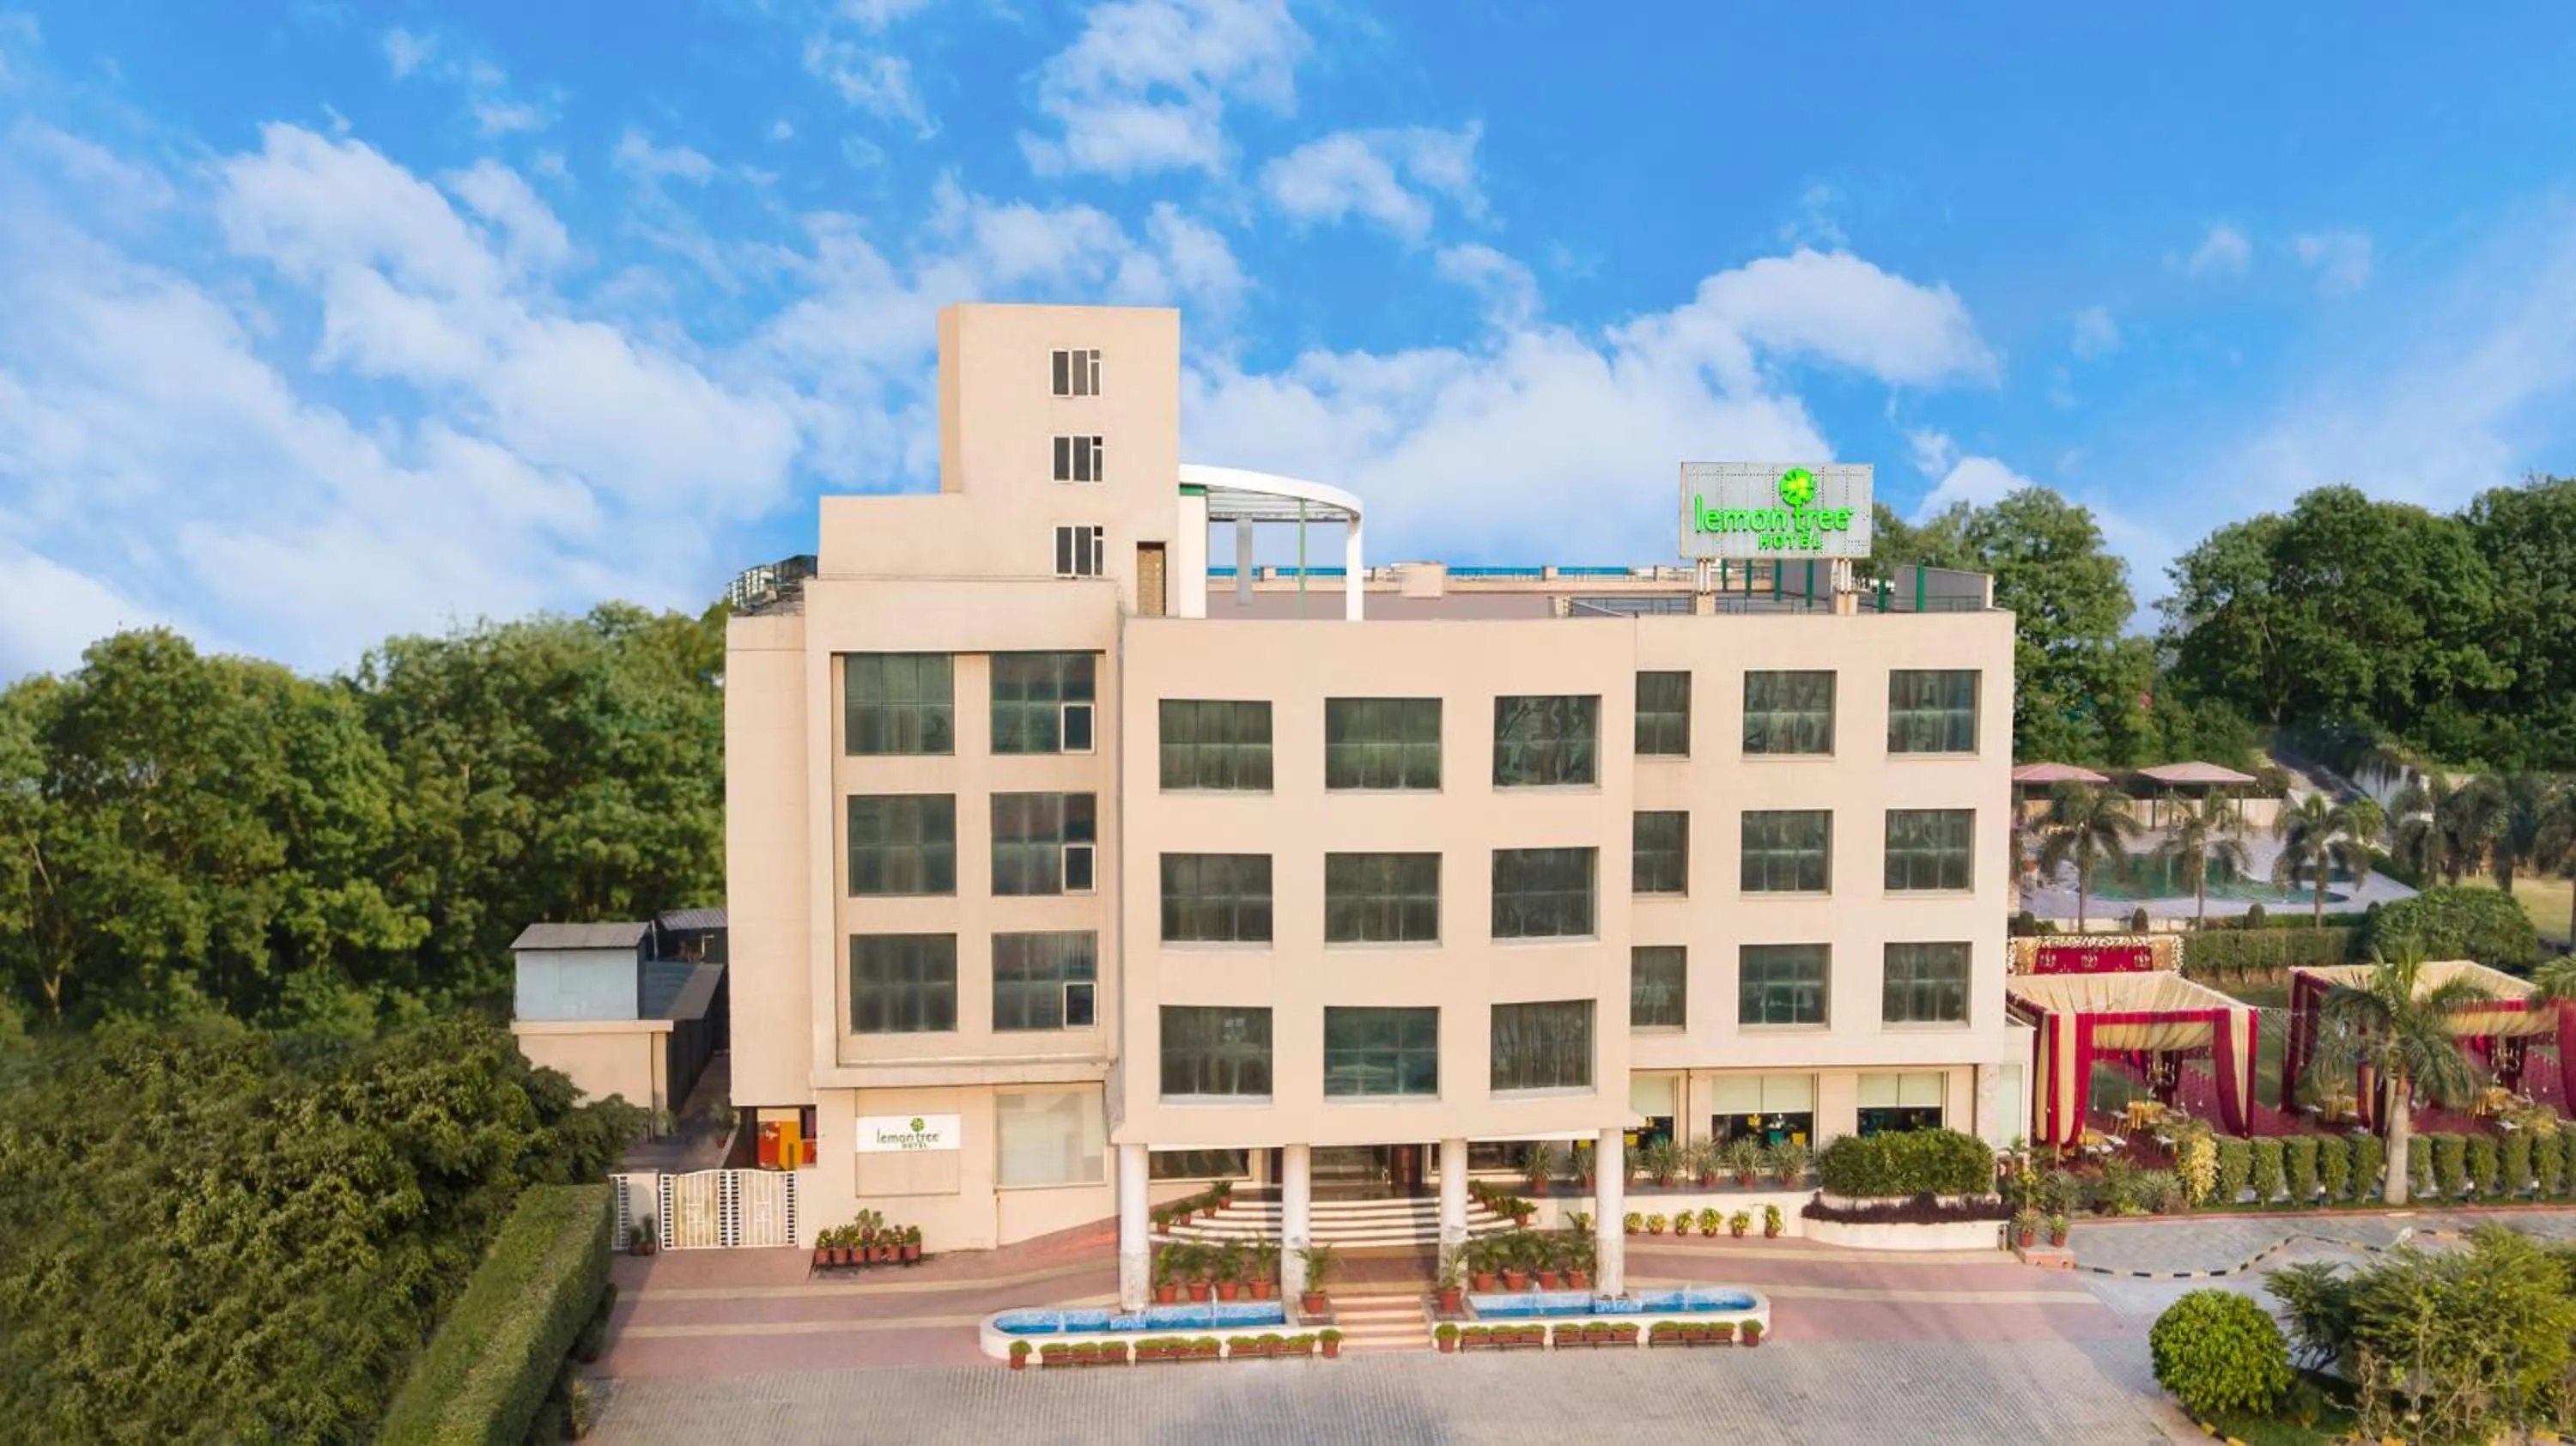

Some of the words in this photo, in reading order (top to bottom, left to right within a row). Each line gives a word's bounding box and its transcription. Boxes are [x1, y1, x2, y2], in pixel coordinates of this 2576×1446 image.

[1694, 494, 1787, 533] lemon
[1791, 505, 1850, 532] tree
[1758, 532, 1823, 550] HOTEL
[877, 1127, 914, 1144] lemon
[916, 1132, 939, 1143] tree
